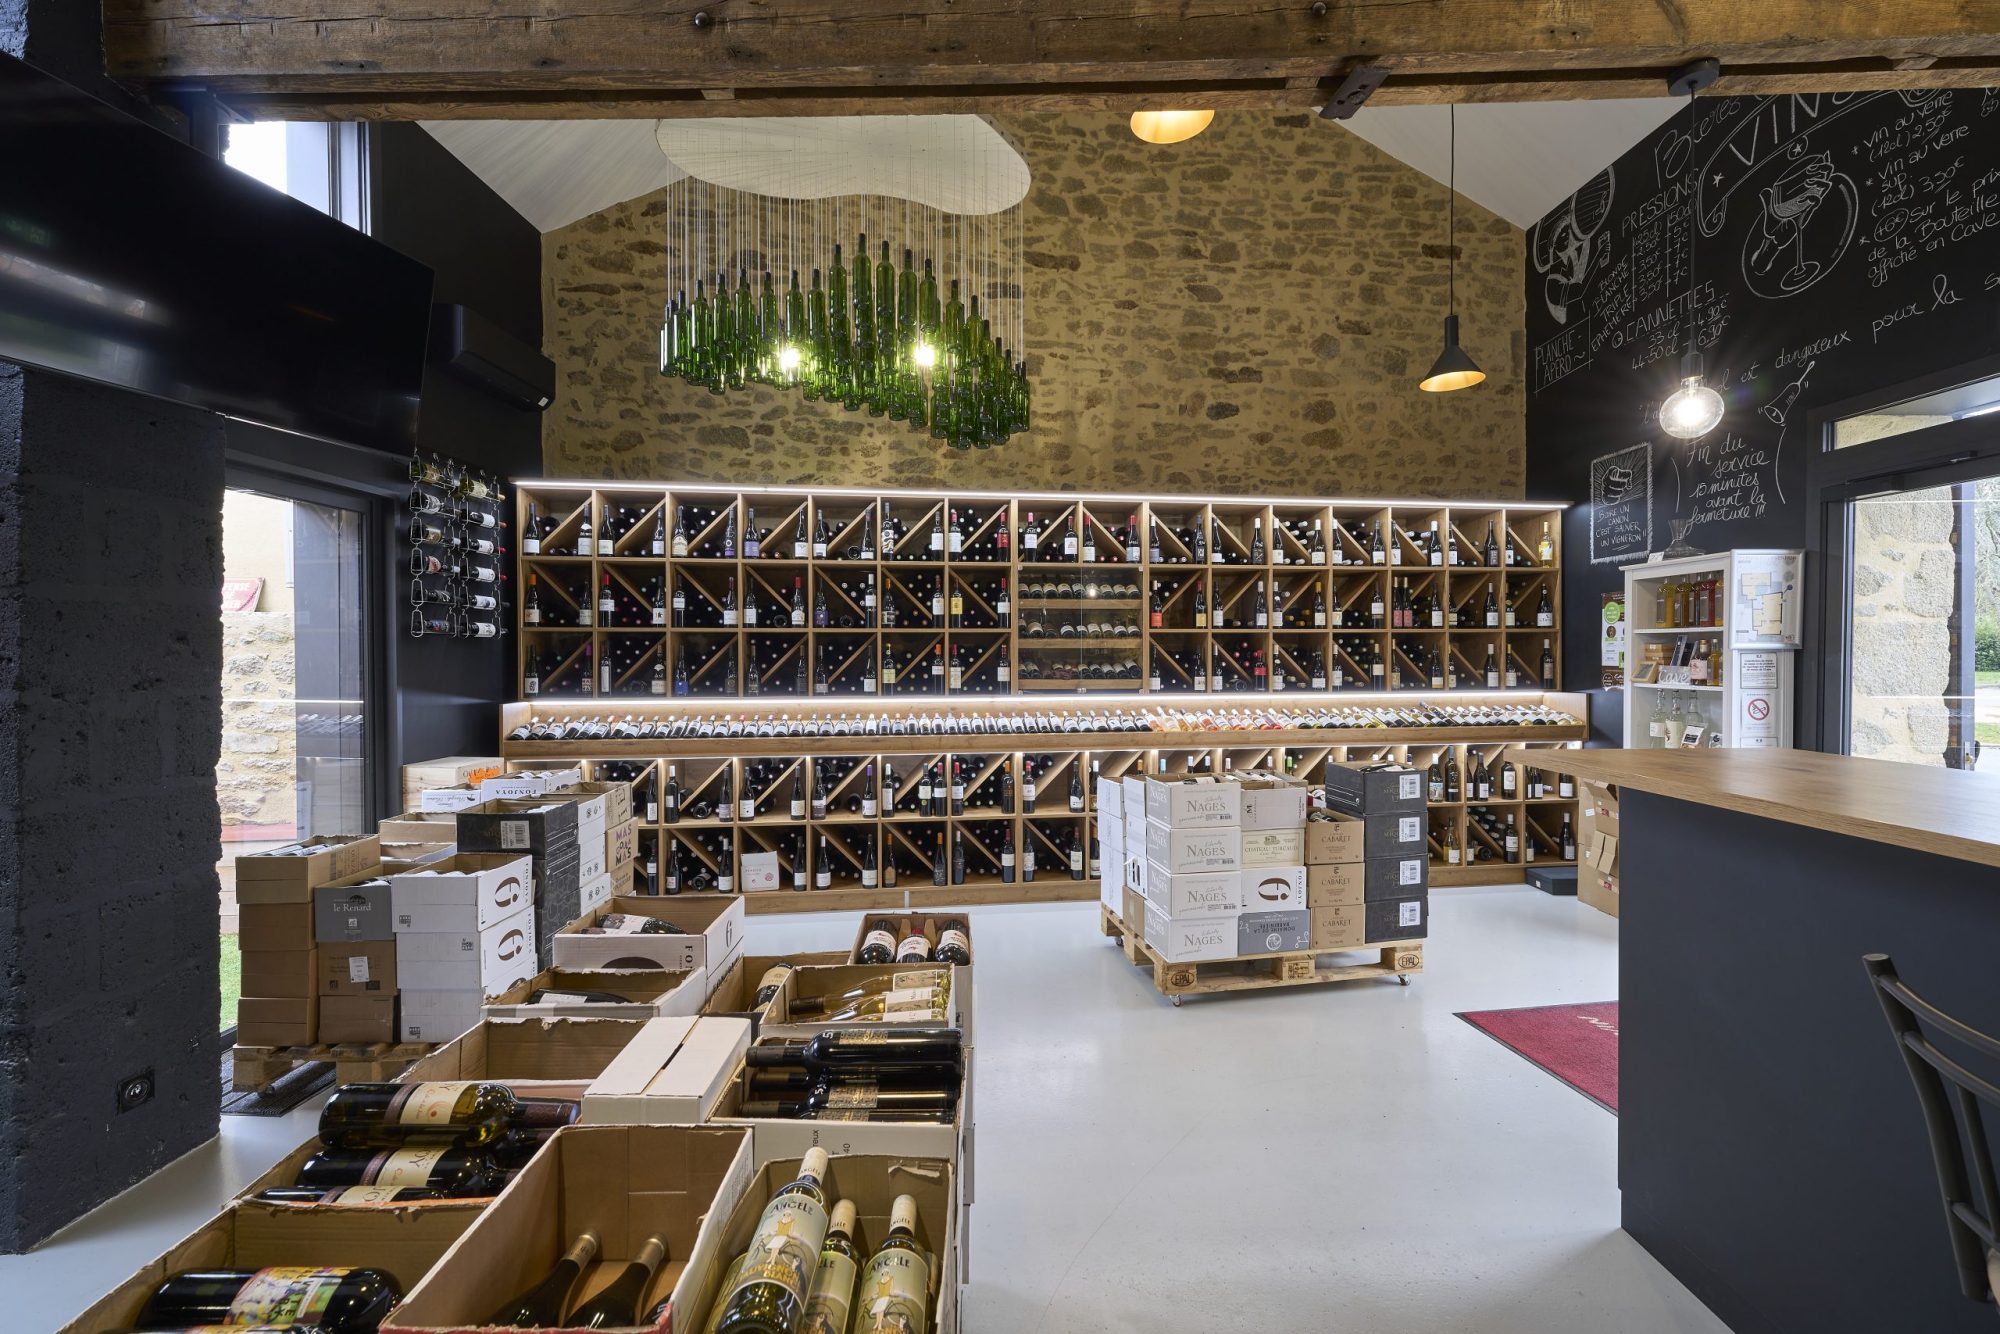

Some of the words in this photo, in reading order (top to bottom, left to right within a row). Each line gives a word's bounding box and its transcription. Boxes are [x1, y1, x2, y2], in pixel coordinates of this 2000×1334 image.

[1896, 113, 1915, 130] au
[1917, 91, 1953, 118] verre
[1909, 145, 1928, 164] au
[1933, 125, 1970, 149] verre
[1622, 168, 1699, 238] PRESSIONS
[1926, 236, 1945, 251] en
[1868, 247, 1888, 261] de
[1626, 280, 1715, 342] CANNETTES
[1775, 330, 1852, 369] dangereux
[1872, 302, 1925, 343] pour
[1931, 273, 1965, 312] la
[1535, 329, 1576, 367] PLANCHE
[1648, 331, 1665, 349] 33
[1720, 432, 1747, 455] du
[1712, 448, 1771, 479] service
[1707, 472, 1761, 495] minutes
[1619, 504, 1631, 515] UN
[1706, 493, 1743, 508] avant
[1608, 515, 1631, 527] CANON
[1614, 520, 1642, 535] SAUVER
[1684, 505, 1750, 537] fermeture
[1600, 538, 1611, 548] UN
[1611, 533, 1642, 545] VIGNERON
[1658, 669, 1689, 684] Cave
[616, 824, 632, 842] MAS
[615, 847, 632, 867] MAS
[343, 903, 372, 912] Renard
